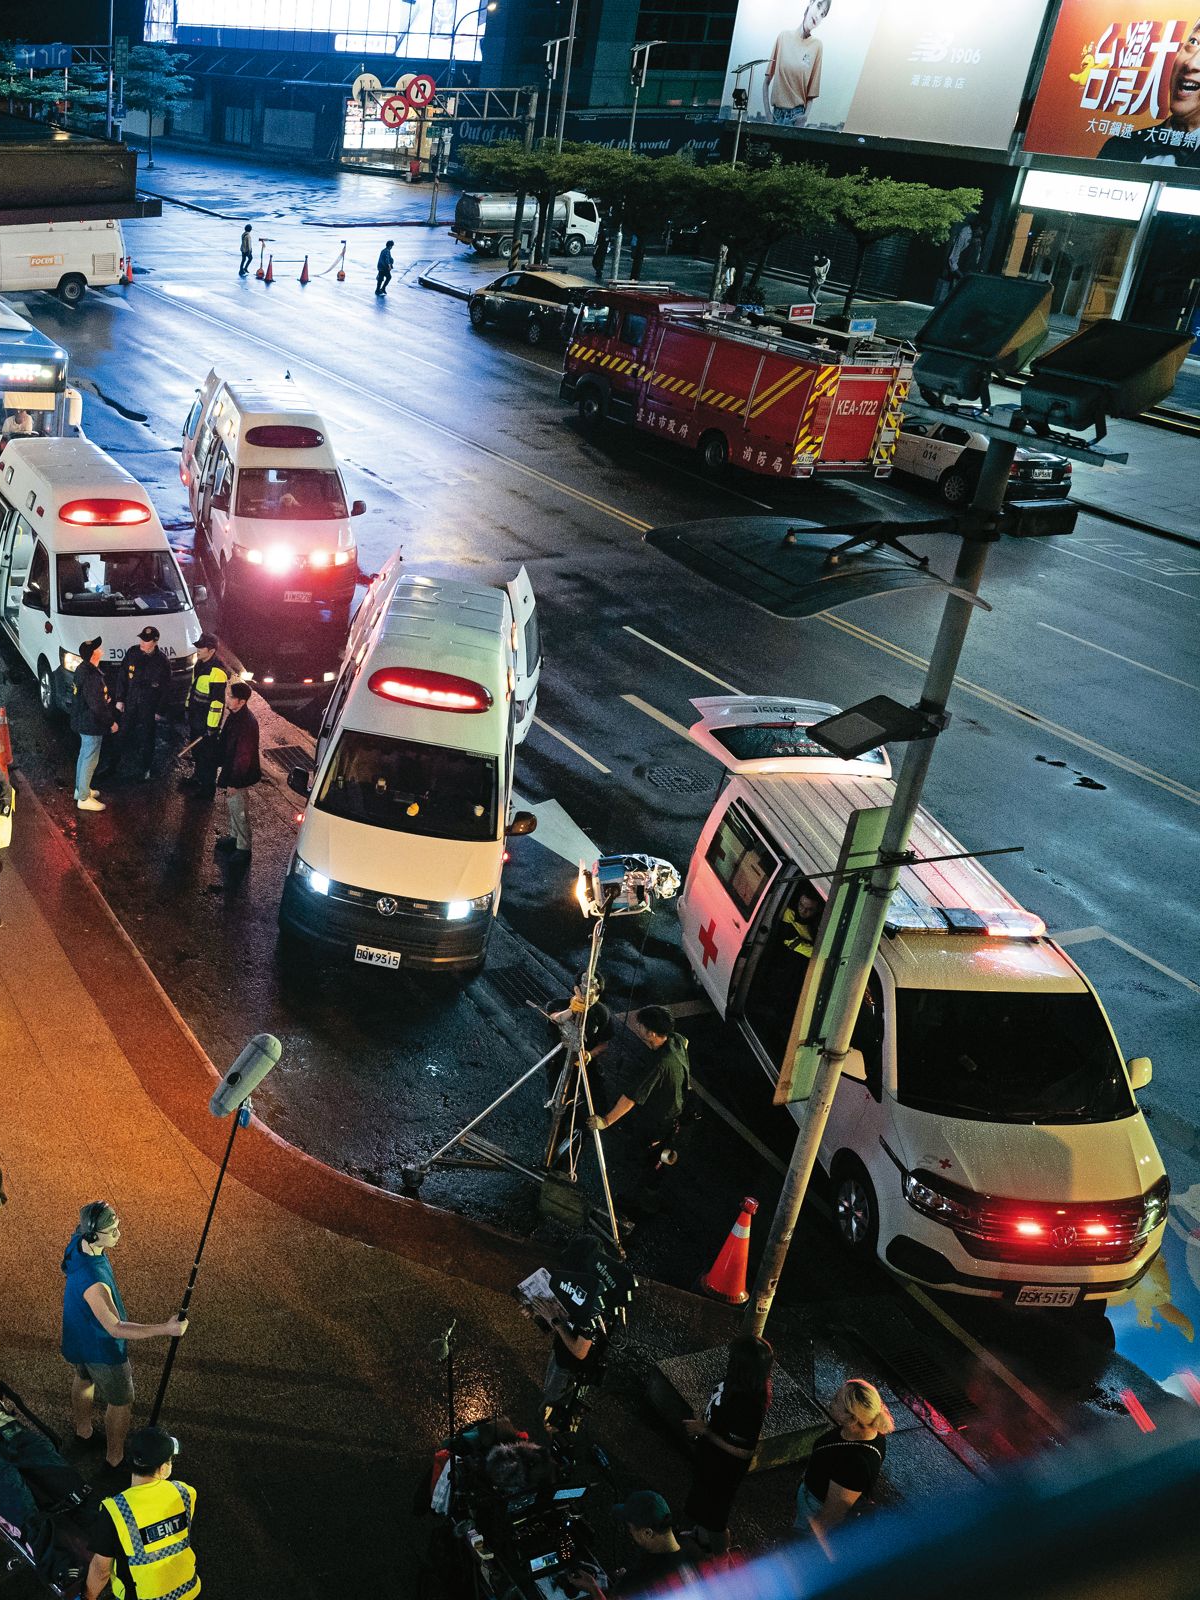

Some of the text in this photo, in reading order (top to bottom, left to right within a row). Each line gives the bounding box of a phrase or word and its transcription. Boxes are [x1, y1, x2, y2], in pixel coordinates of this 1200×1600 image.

[950, 48, 981, 64] 1906
[460, 121, 481, 140] Out
[482, 125, 497, 143] of
[500, 127, 522, 140] thi
[617, 138, 638, 150] ths
[640, 138, 671, 150] world
[687, 138, 720, 152] Out of
[31, 257, 55, 266] FOCUS
[835, 400, 879, 415] KEA-1722
[743, 446, 783, 473] 消防局
[922, 450, 938, 461] 014
[1017, 1291, 1075, 1304] BSK-5151
[156, 1519, 180, 1537] EMT
